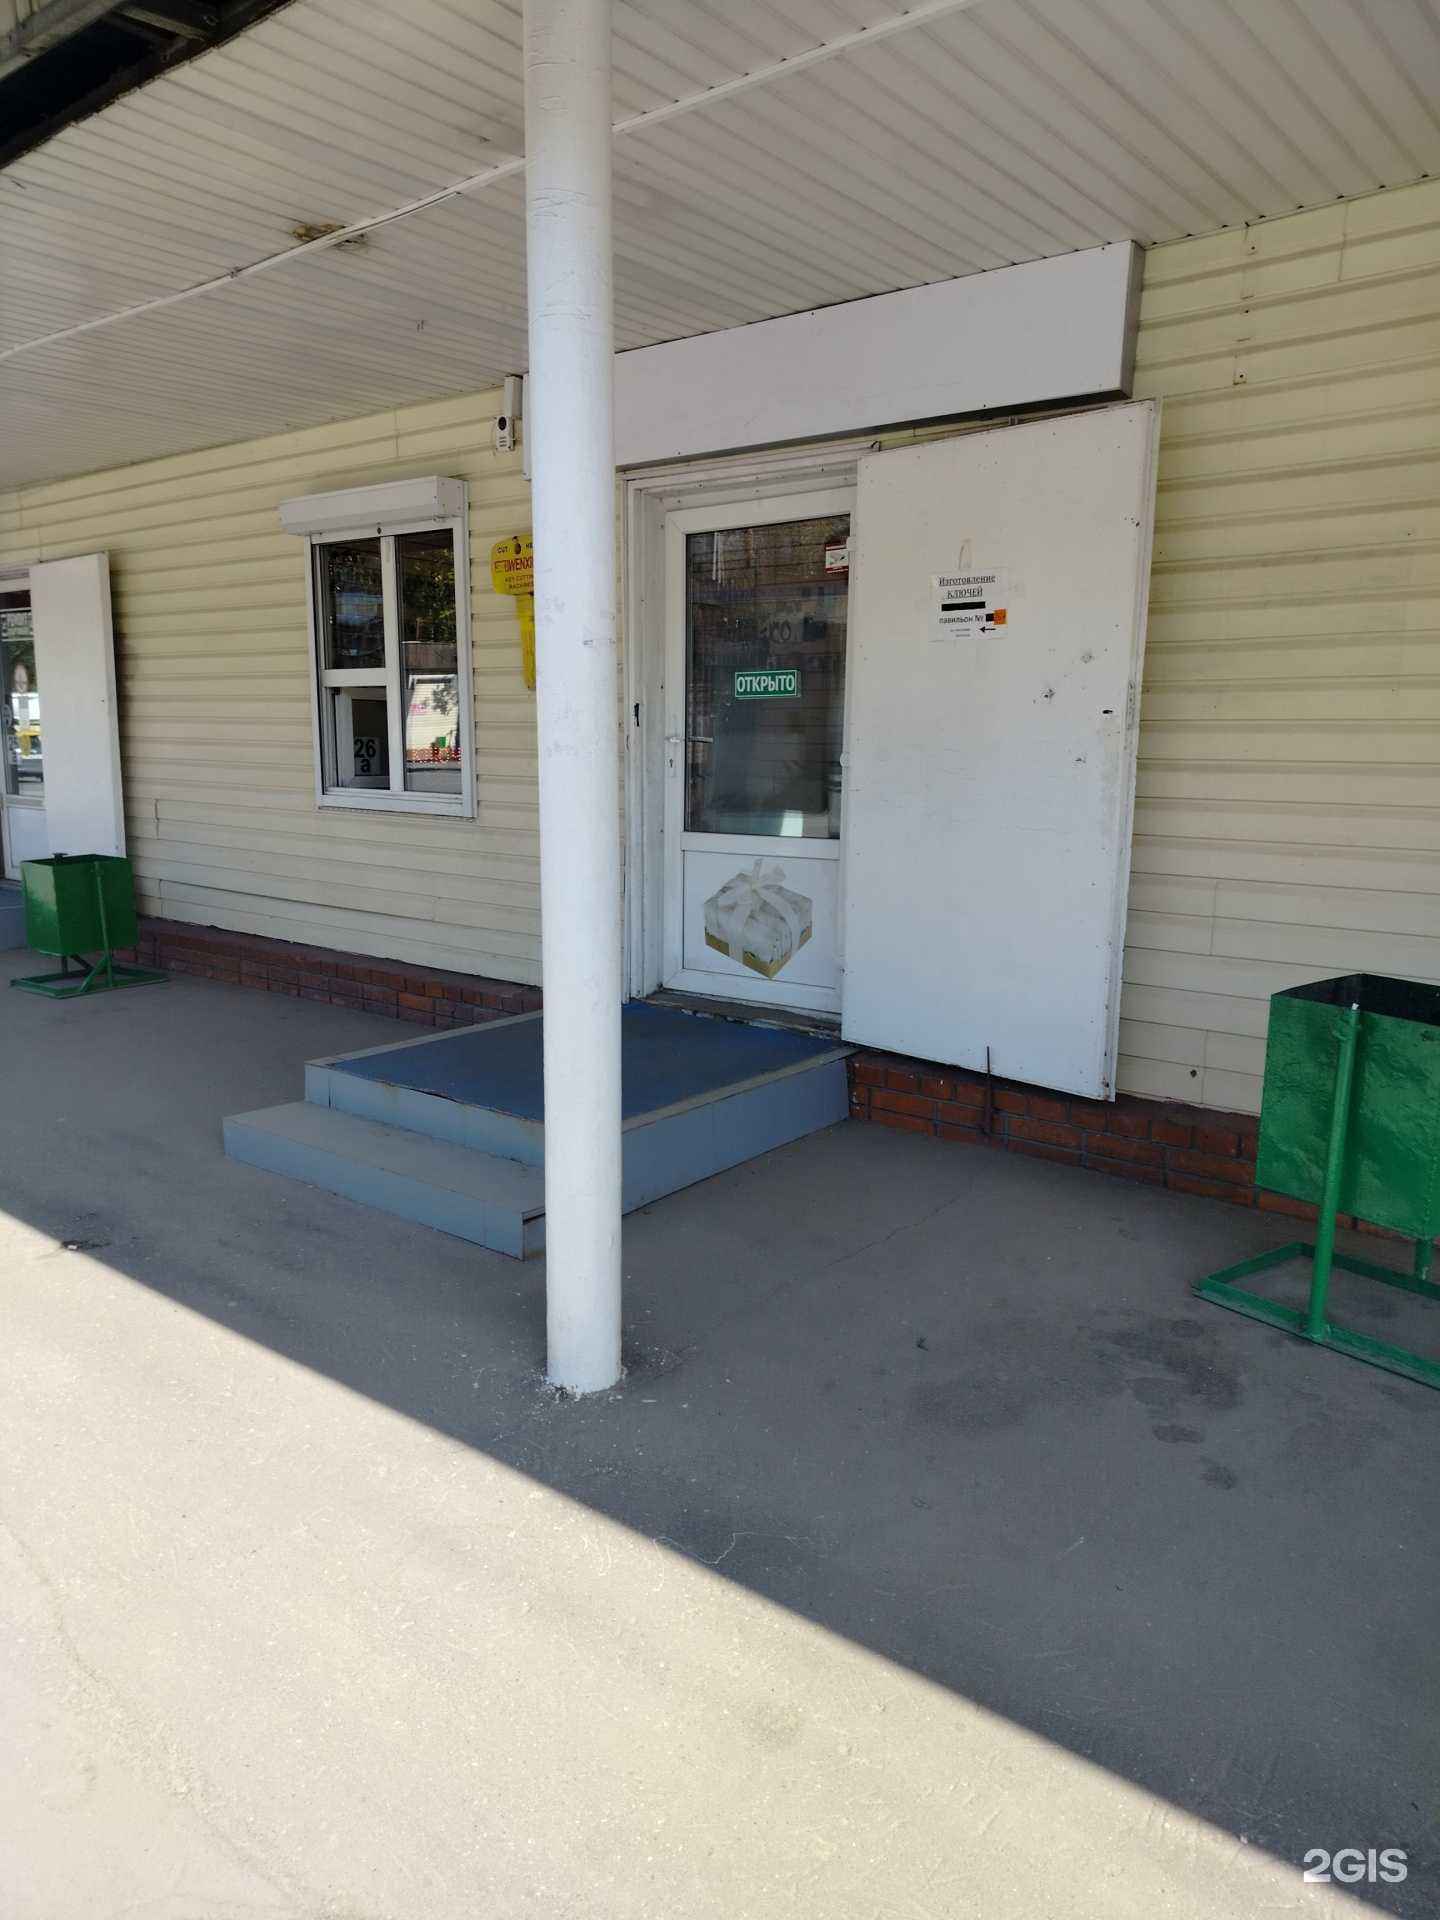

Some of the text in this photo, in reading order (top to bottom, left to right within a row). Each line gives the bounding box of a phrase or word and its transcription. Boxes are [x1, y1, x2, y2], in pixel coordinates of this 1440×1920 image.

[939, 575, 996, 586] Изготовление
[947, 586, 983, 599] КЛЮЧЕЙ
[737, 675, 795, 692] ОТКРЫТО
[354, 738, 377, 758] 26
